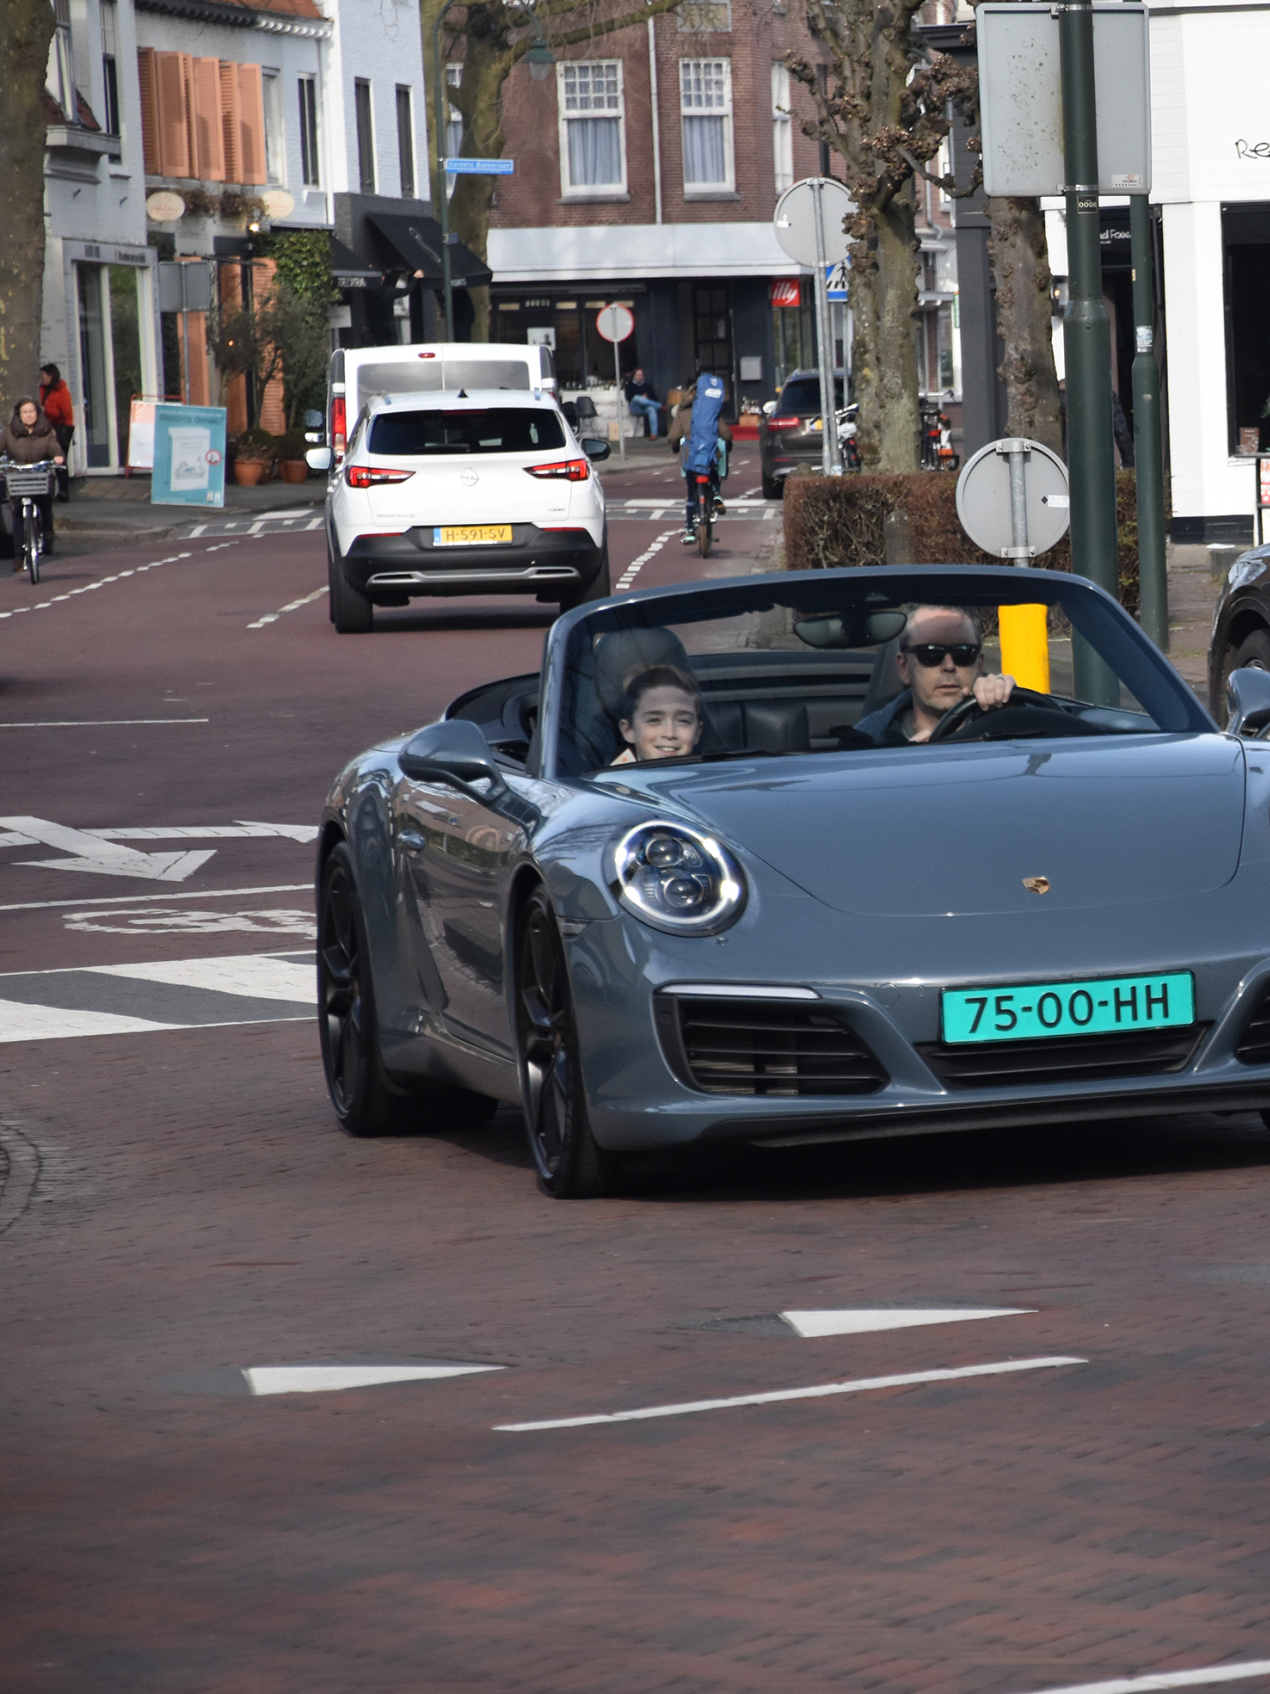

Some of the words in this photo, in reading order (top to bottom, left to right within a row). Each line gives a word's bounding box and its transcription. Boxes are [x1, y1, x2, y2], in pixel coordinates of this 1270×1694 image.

[773, 282, 798, 304] illy
[446, 528, 505, 541] H-591-SV
[964, 983, 1169, 1034] 75-00-HH
